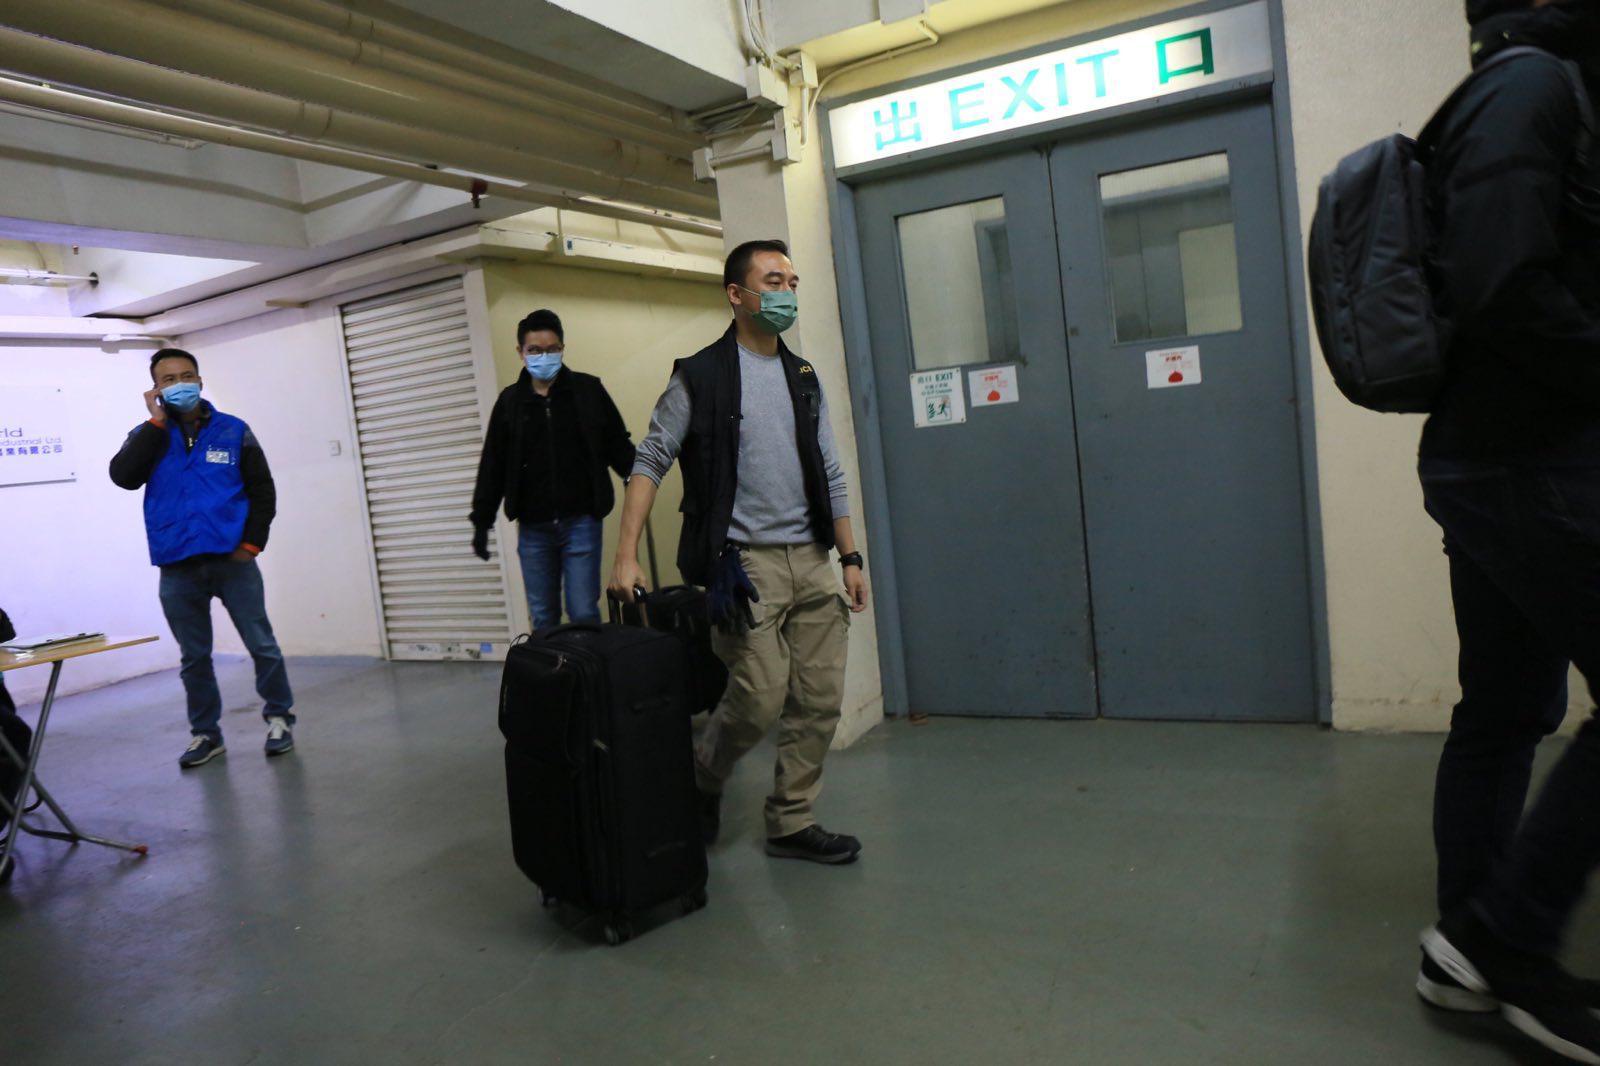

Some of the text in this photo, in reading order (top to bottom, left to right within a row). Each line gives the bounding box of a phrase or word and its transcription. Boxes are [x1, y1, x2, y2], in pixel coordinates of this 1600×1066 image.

[873, 26, 1215, 151] 出 EXIT 口
[935, 372, 954, 382] EXIT
[0, 444, 63, 456] 業有限公司
